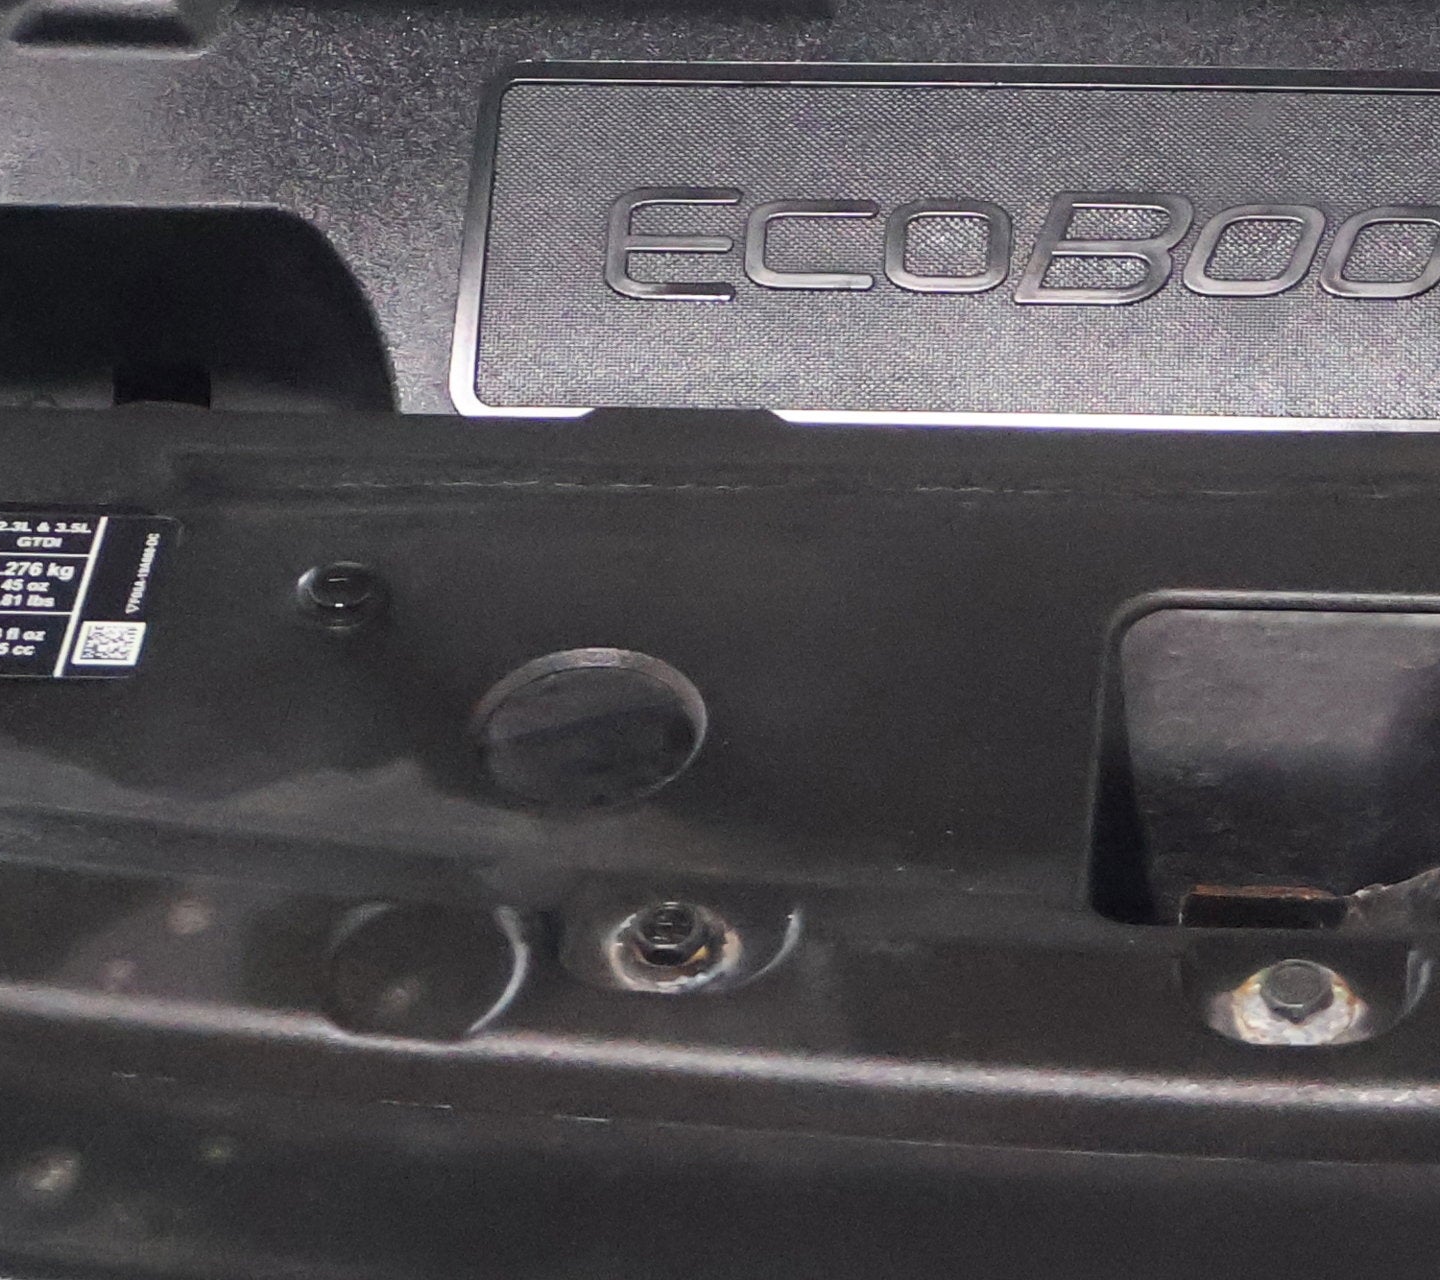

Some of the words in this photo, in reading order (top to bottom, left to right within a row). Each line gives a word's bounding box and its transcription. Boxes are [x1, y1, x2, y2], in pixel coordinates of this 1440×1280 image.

[36, 521, 50, 533] &
[47, 562, 75, 581] kg
[0, 579, 24, 591] 45
[26, 581, 50, 592] oz
[26, 594, 55, 608] lbs
[22, 630, 46, 641] oz
[12, 644, 35, 656] cc
